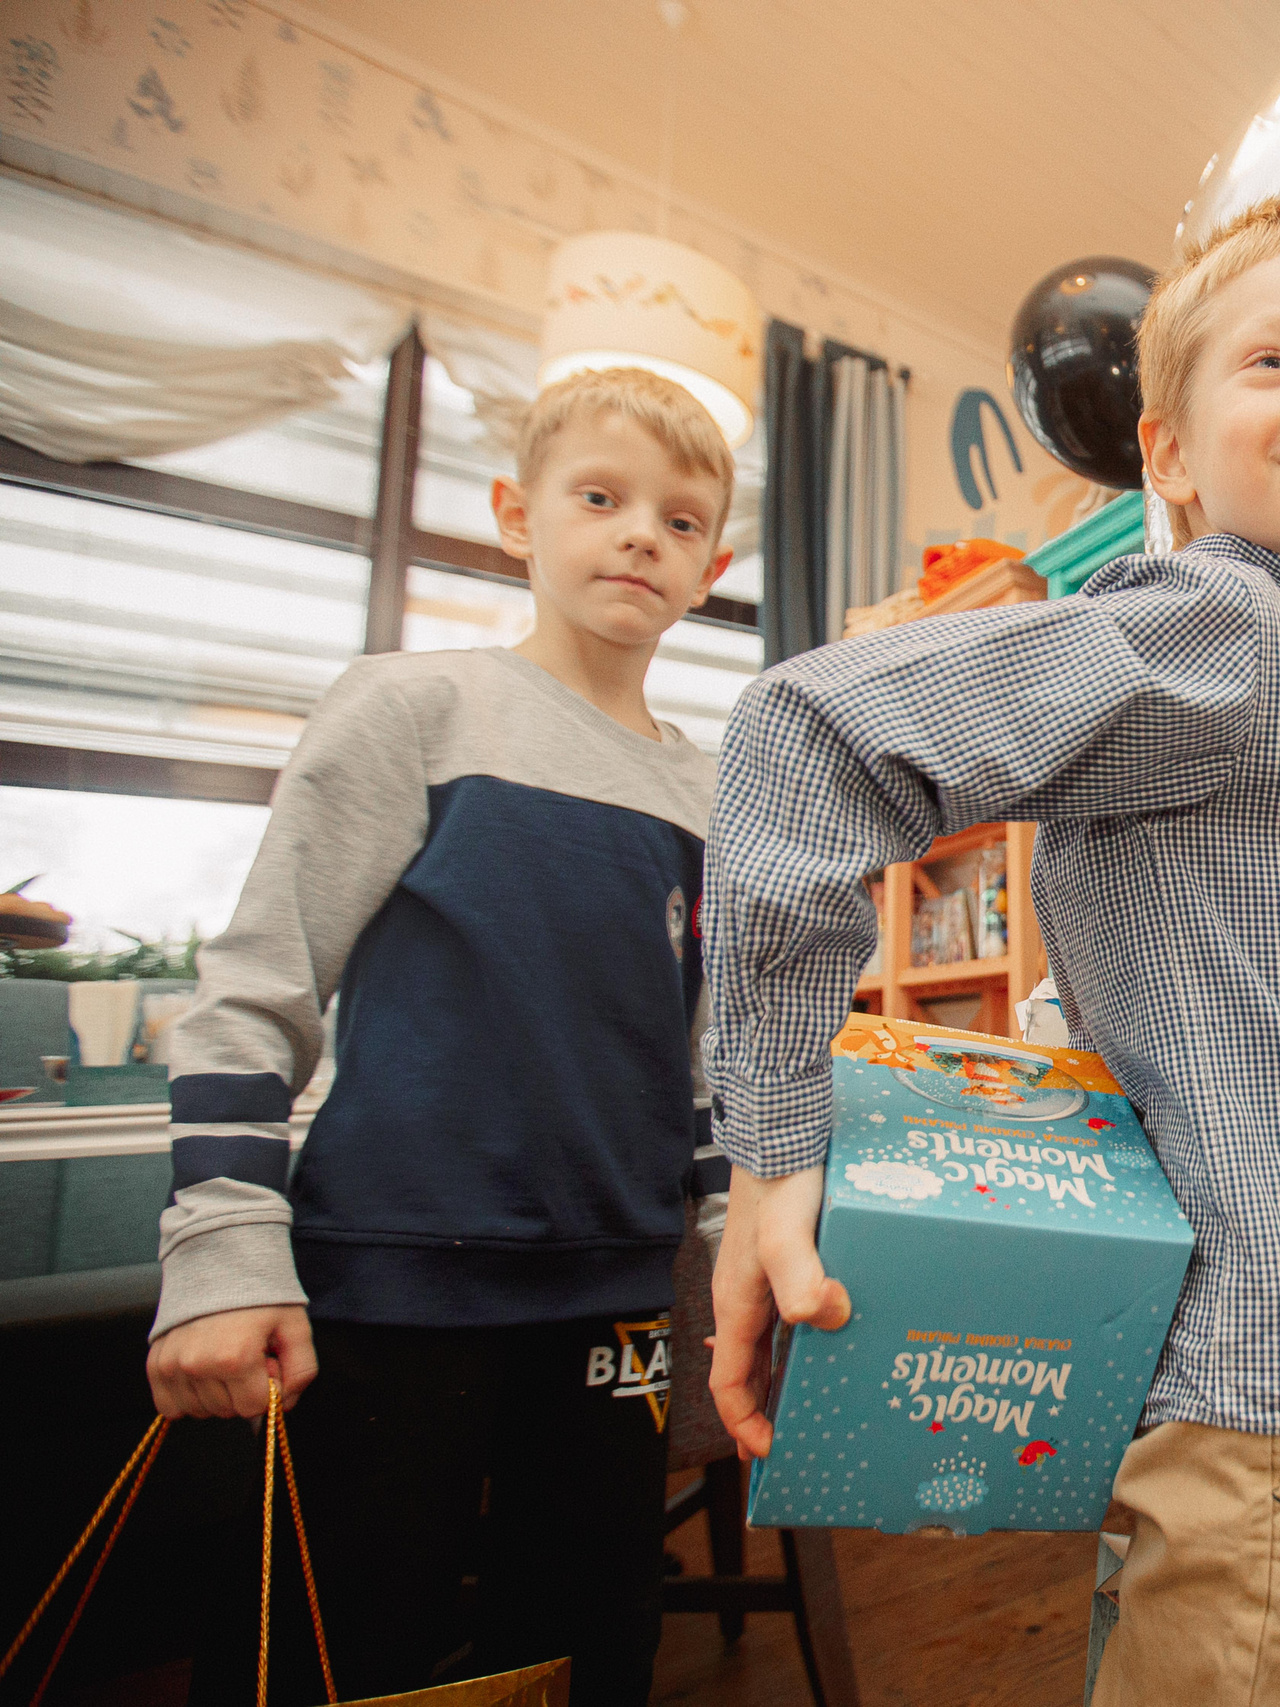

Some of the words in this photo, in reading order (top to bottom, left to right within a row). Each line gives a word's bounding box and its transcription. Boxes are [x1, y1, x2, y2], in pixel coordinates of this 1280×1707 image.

[907, 1130, 1116, 1181] Moments
[942, 1157, 1097, 1209] Magic
[891, 1350, 1073, 1401] Moments
[909, 1382, 1036, 1437] Magic
